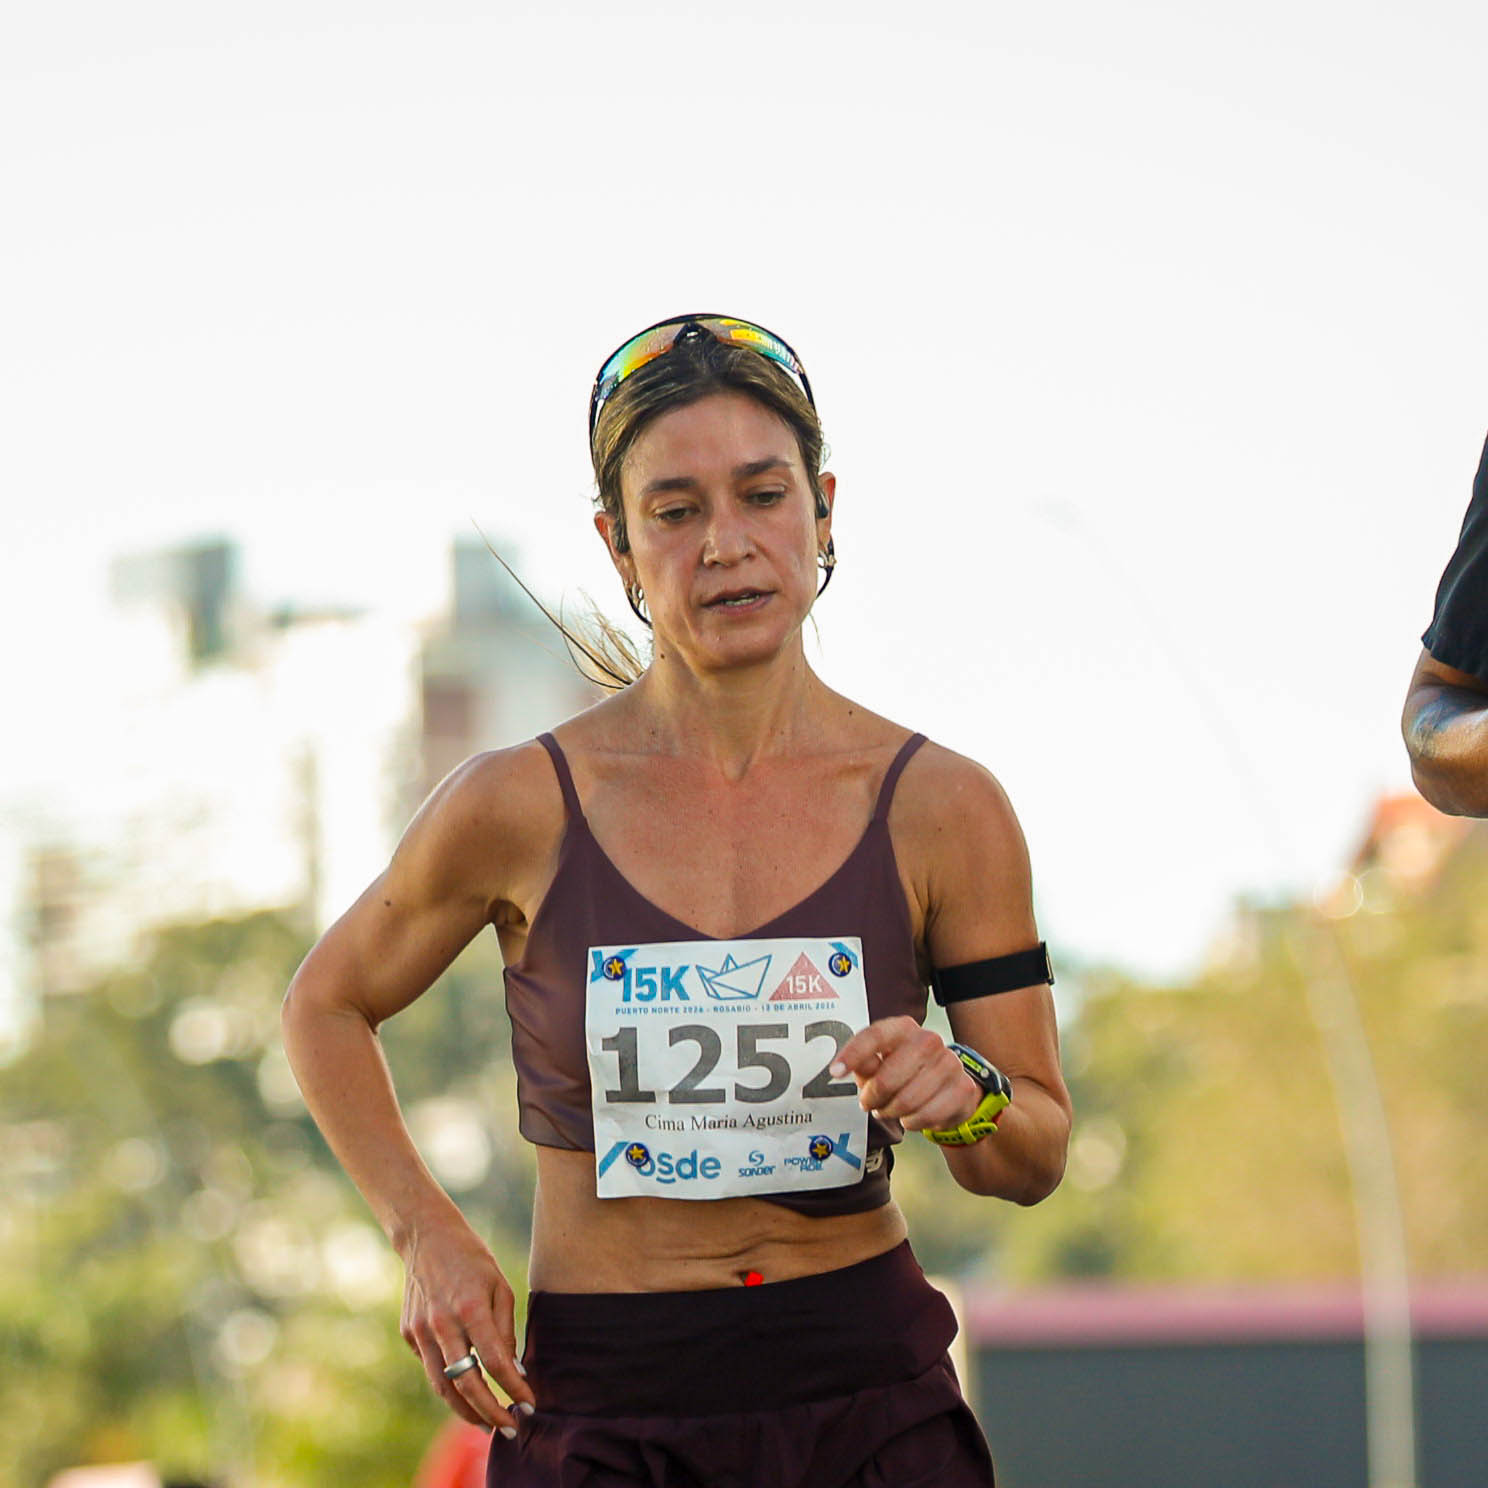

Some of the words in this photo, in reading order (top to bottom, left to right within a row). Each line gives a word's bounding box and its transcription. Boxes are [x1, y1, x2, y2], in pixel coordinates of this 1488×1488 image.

[621, 965, 690, 1002] 15K
[786, 974, 823, 994] 15K
[615, 1007, 649, 1015] PUERTO
[651, 1006, 680, 1014] NORTE
[713, 1004, 751, 1013] ROSARIO
[787, 1002, 812, 1010] ABRIL
[601, 1020, 858, 1104] 1252
[645, 1114, 685, 1131] Cima
[691, 1114, 737, 1130] Maria
[743, 1110, 812, 1131] Agustina
